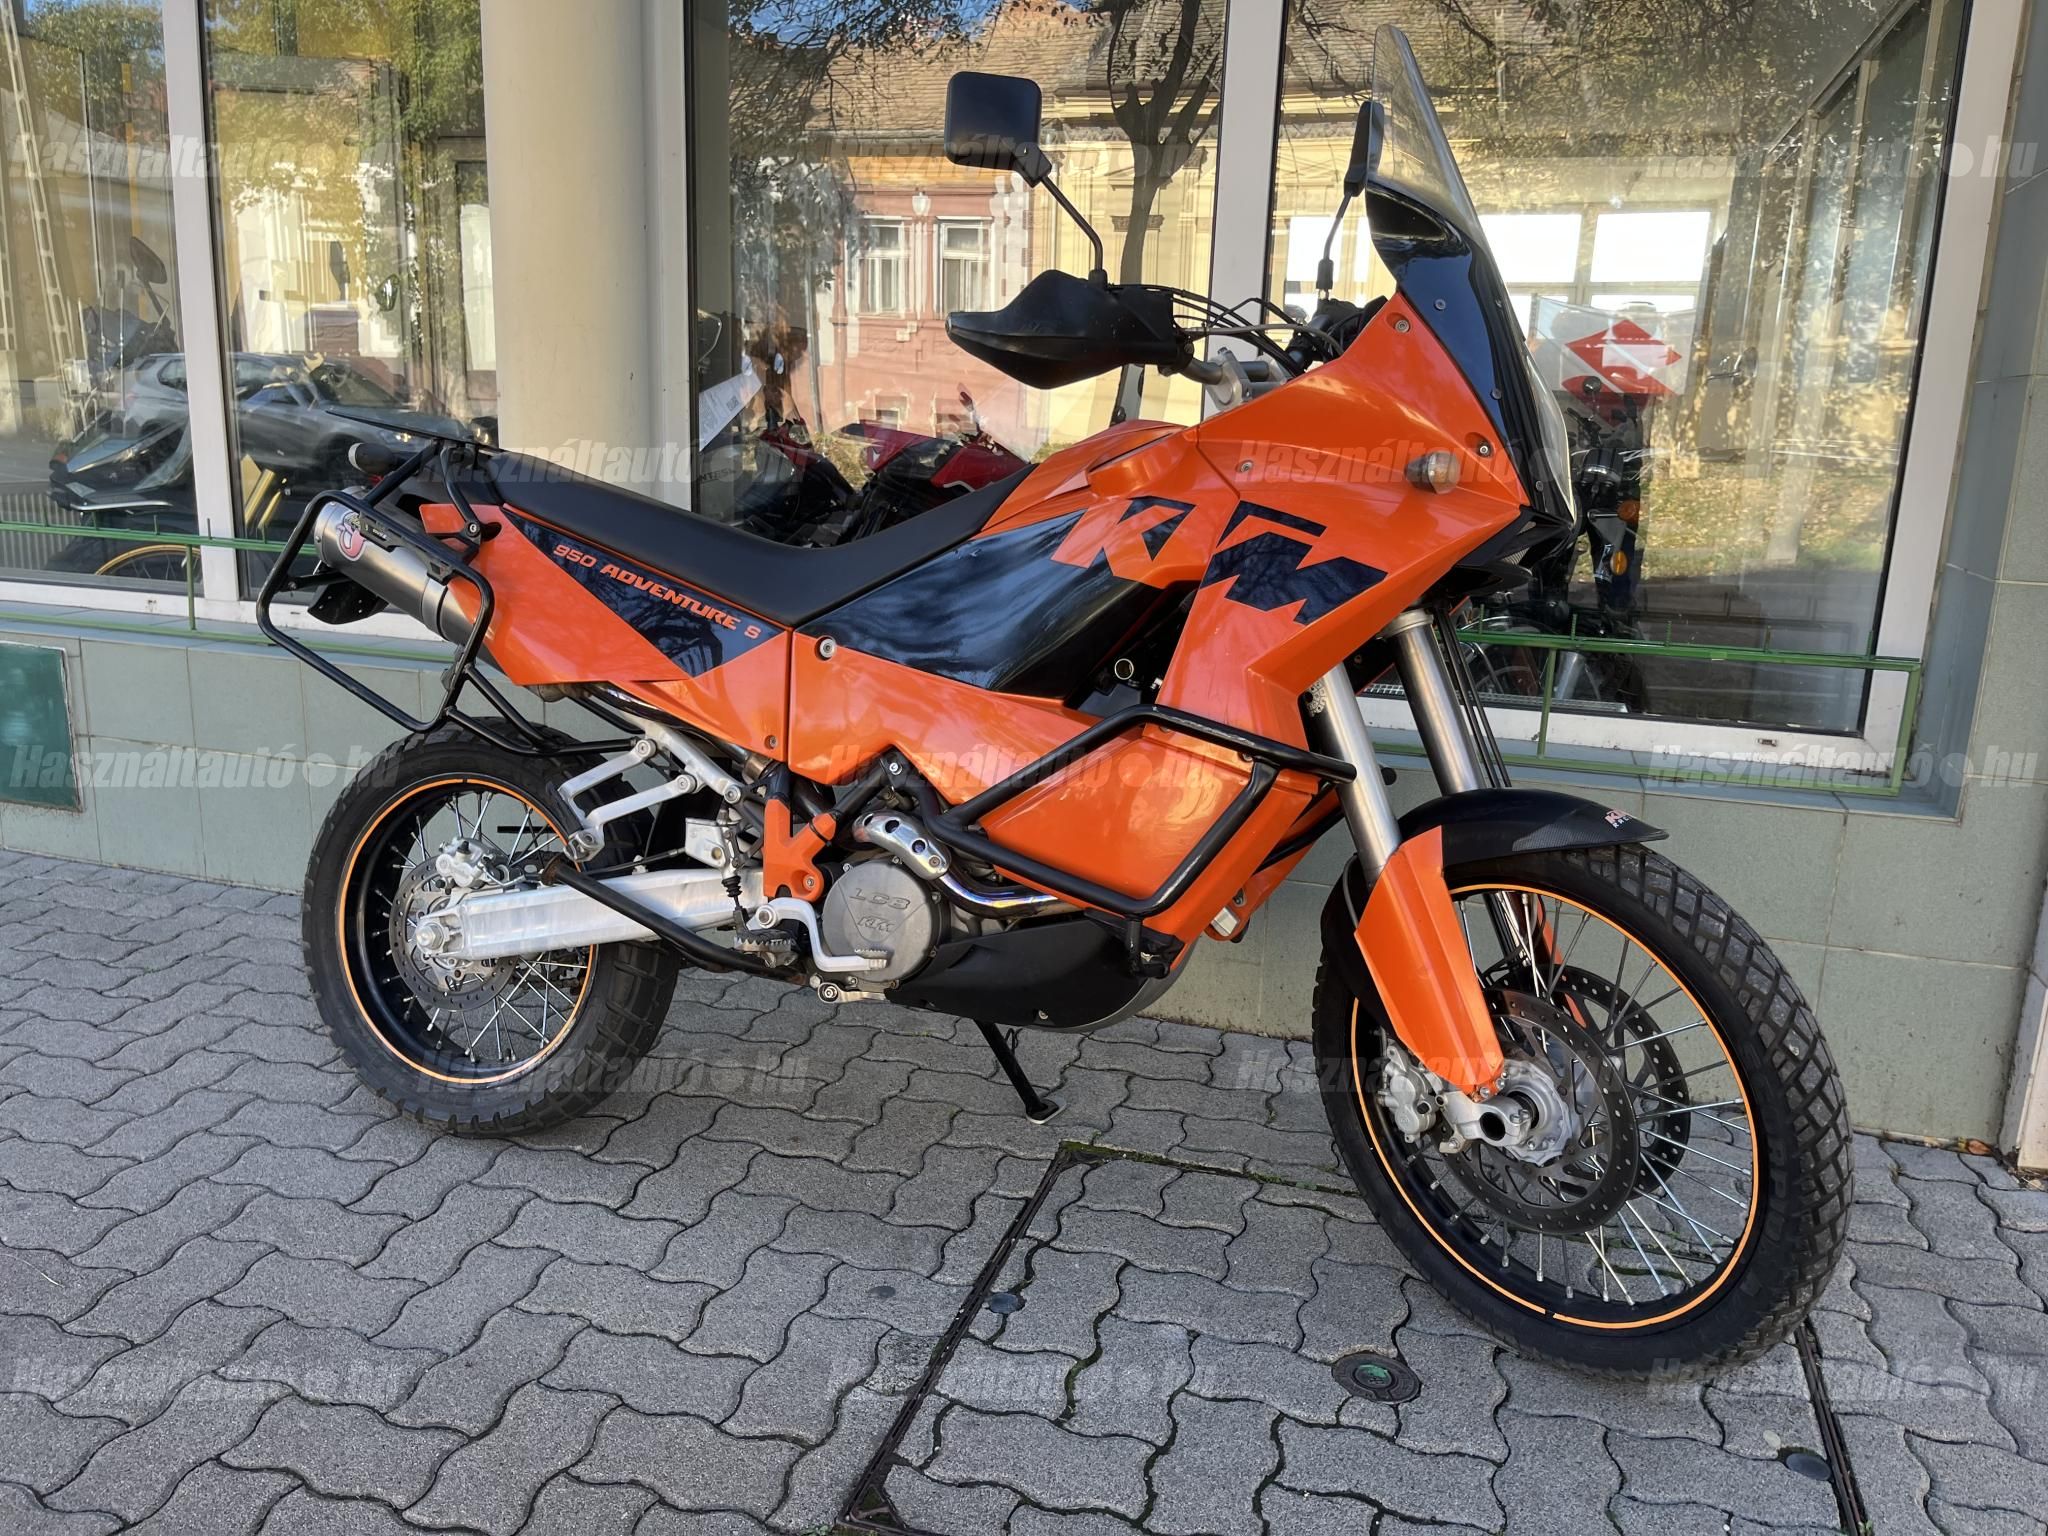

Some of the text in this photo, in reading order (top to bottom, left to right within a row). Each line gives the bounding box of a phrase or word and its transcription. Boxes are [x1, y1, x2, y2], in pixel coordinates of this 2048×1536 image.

[553, 543, 762, 640] 950 ADVENTURE S
